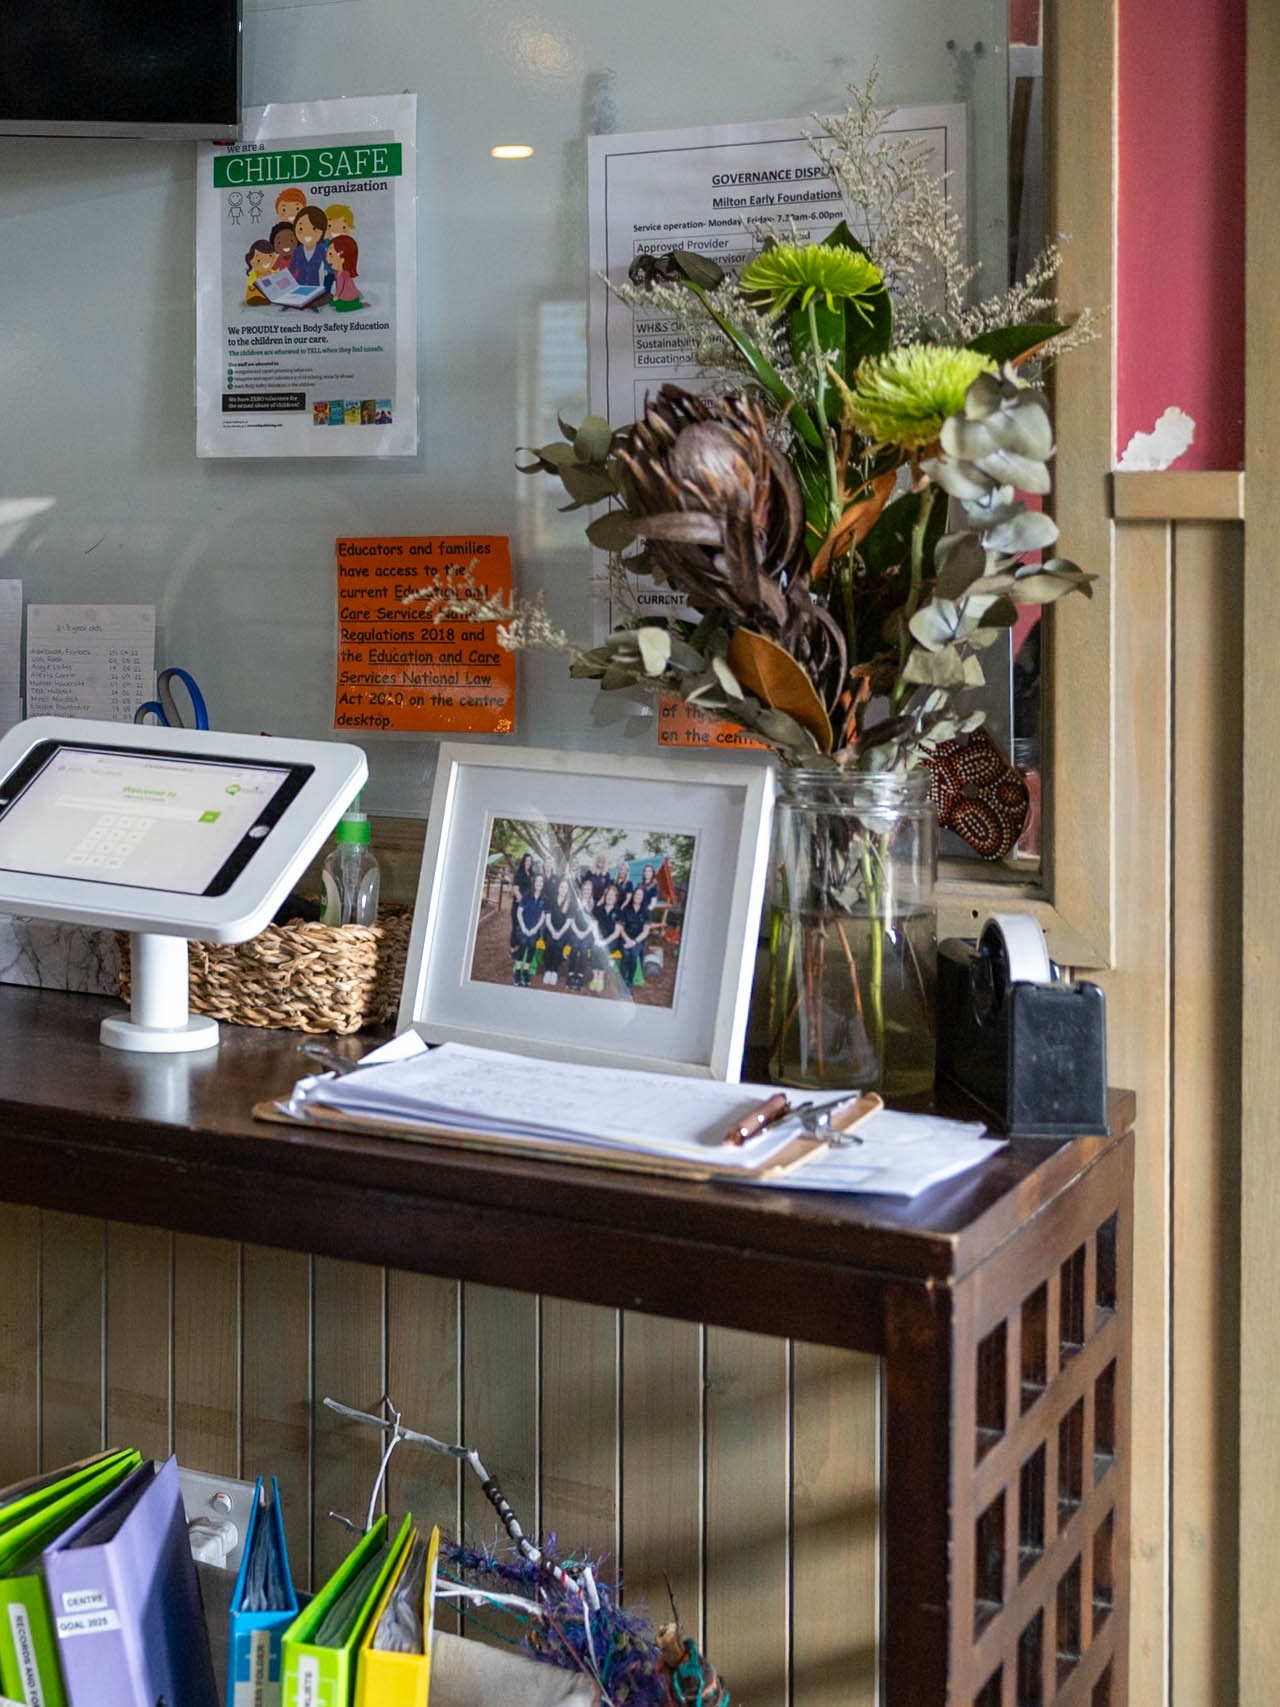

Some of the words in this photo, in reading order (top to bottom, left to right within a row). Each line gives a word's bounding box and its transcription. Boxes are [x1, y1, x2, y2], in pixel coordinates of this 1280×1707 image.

[241, 144, 257, 152] are
[226, 154, 311, 184] CHILD
[318, 148, 389, 178] SAFE
[711, 168, 792, 186] GOVERNANCE
[310, 180, 388, 197] organization
[712, 197, 747, 208] Milton
[749, 195, 775, 207] Early
[777, 190, 842, 203] Foundations
[633, 223, 661, 232] Service
[663, 221, 706, 231] operation-
[708, 218, 742, 228] Monday
[637, 240, 685, 253] Approved
[687, 238, 729, 249] Provider
[228, 326, 240, 335] We
[241, 325, 279, 334] PROUDLY
[280, 324, 301, 333] teach
[303, 323, 322, 333] Body
[323, 322, 348, 333] Safety
[350, 321, 389, 330] Education
[636, 323, 668, 333] WH&S
[250, 337, 283, 345] children
[284, 336, 292, 344] in
[338, 542, 403, 556] Educators
[410, 541, 433, 556] and
[439, 541, 491, 555] families
[339, 565, 369, 577] have
[375, 566, 418, 577] access
[424, 564, 438, 577] to
[340, 586, 388, 599] current
[637, 594, 685, 605] CURRENT
[340, 607, 370, 620] Care
[377, 607, 433, 620] Services
[341, 628, 415, 642] Regulations
[421, 628, 455, 641] 2018
[461, 628, 485, 641] and
[341, 649, 363, 662] the
[369, 650, 433, 663] Education
[439, 651, 463, 663] and
[468, 651, 500, 664] Care
[339, 671, 397, 684] Services
[402, 671, 460, 685] National
[465, 673, 491, 685] Law
[339, 692, 363, 705] Act
[369, 692, 404, 705] 2010
[410, 695, 425, 706] on
[430, 694, 453, 706] the
[459, 696, 505, 708] centre
[662, 704, 678, 718] of
[336, 713, 395, 730] desktop.
[662, 731, 678, 742] on
[685, 729, 709, 743] the
[67, 1594, 103, 1607] CENTRE
[60, 1621, 84, 1631] GOAL
[16, 1615, 31, 1665] RECORDS
[26, 1667, 36, 1689] AND
